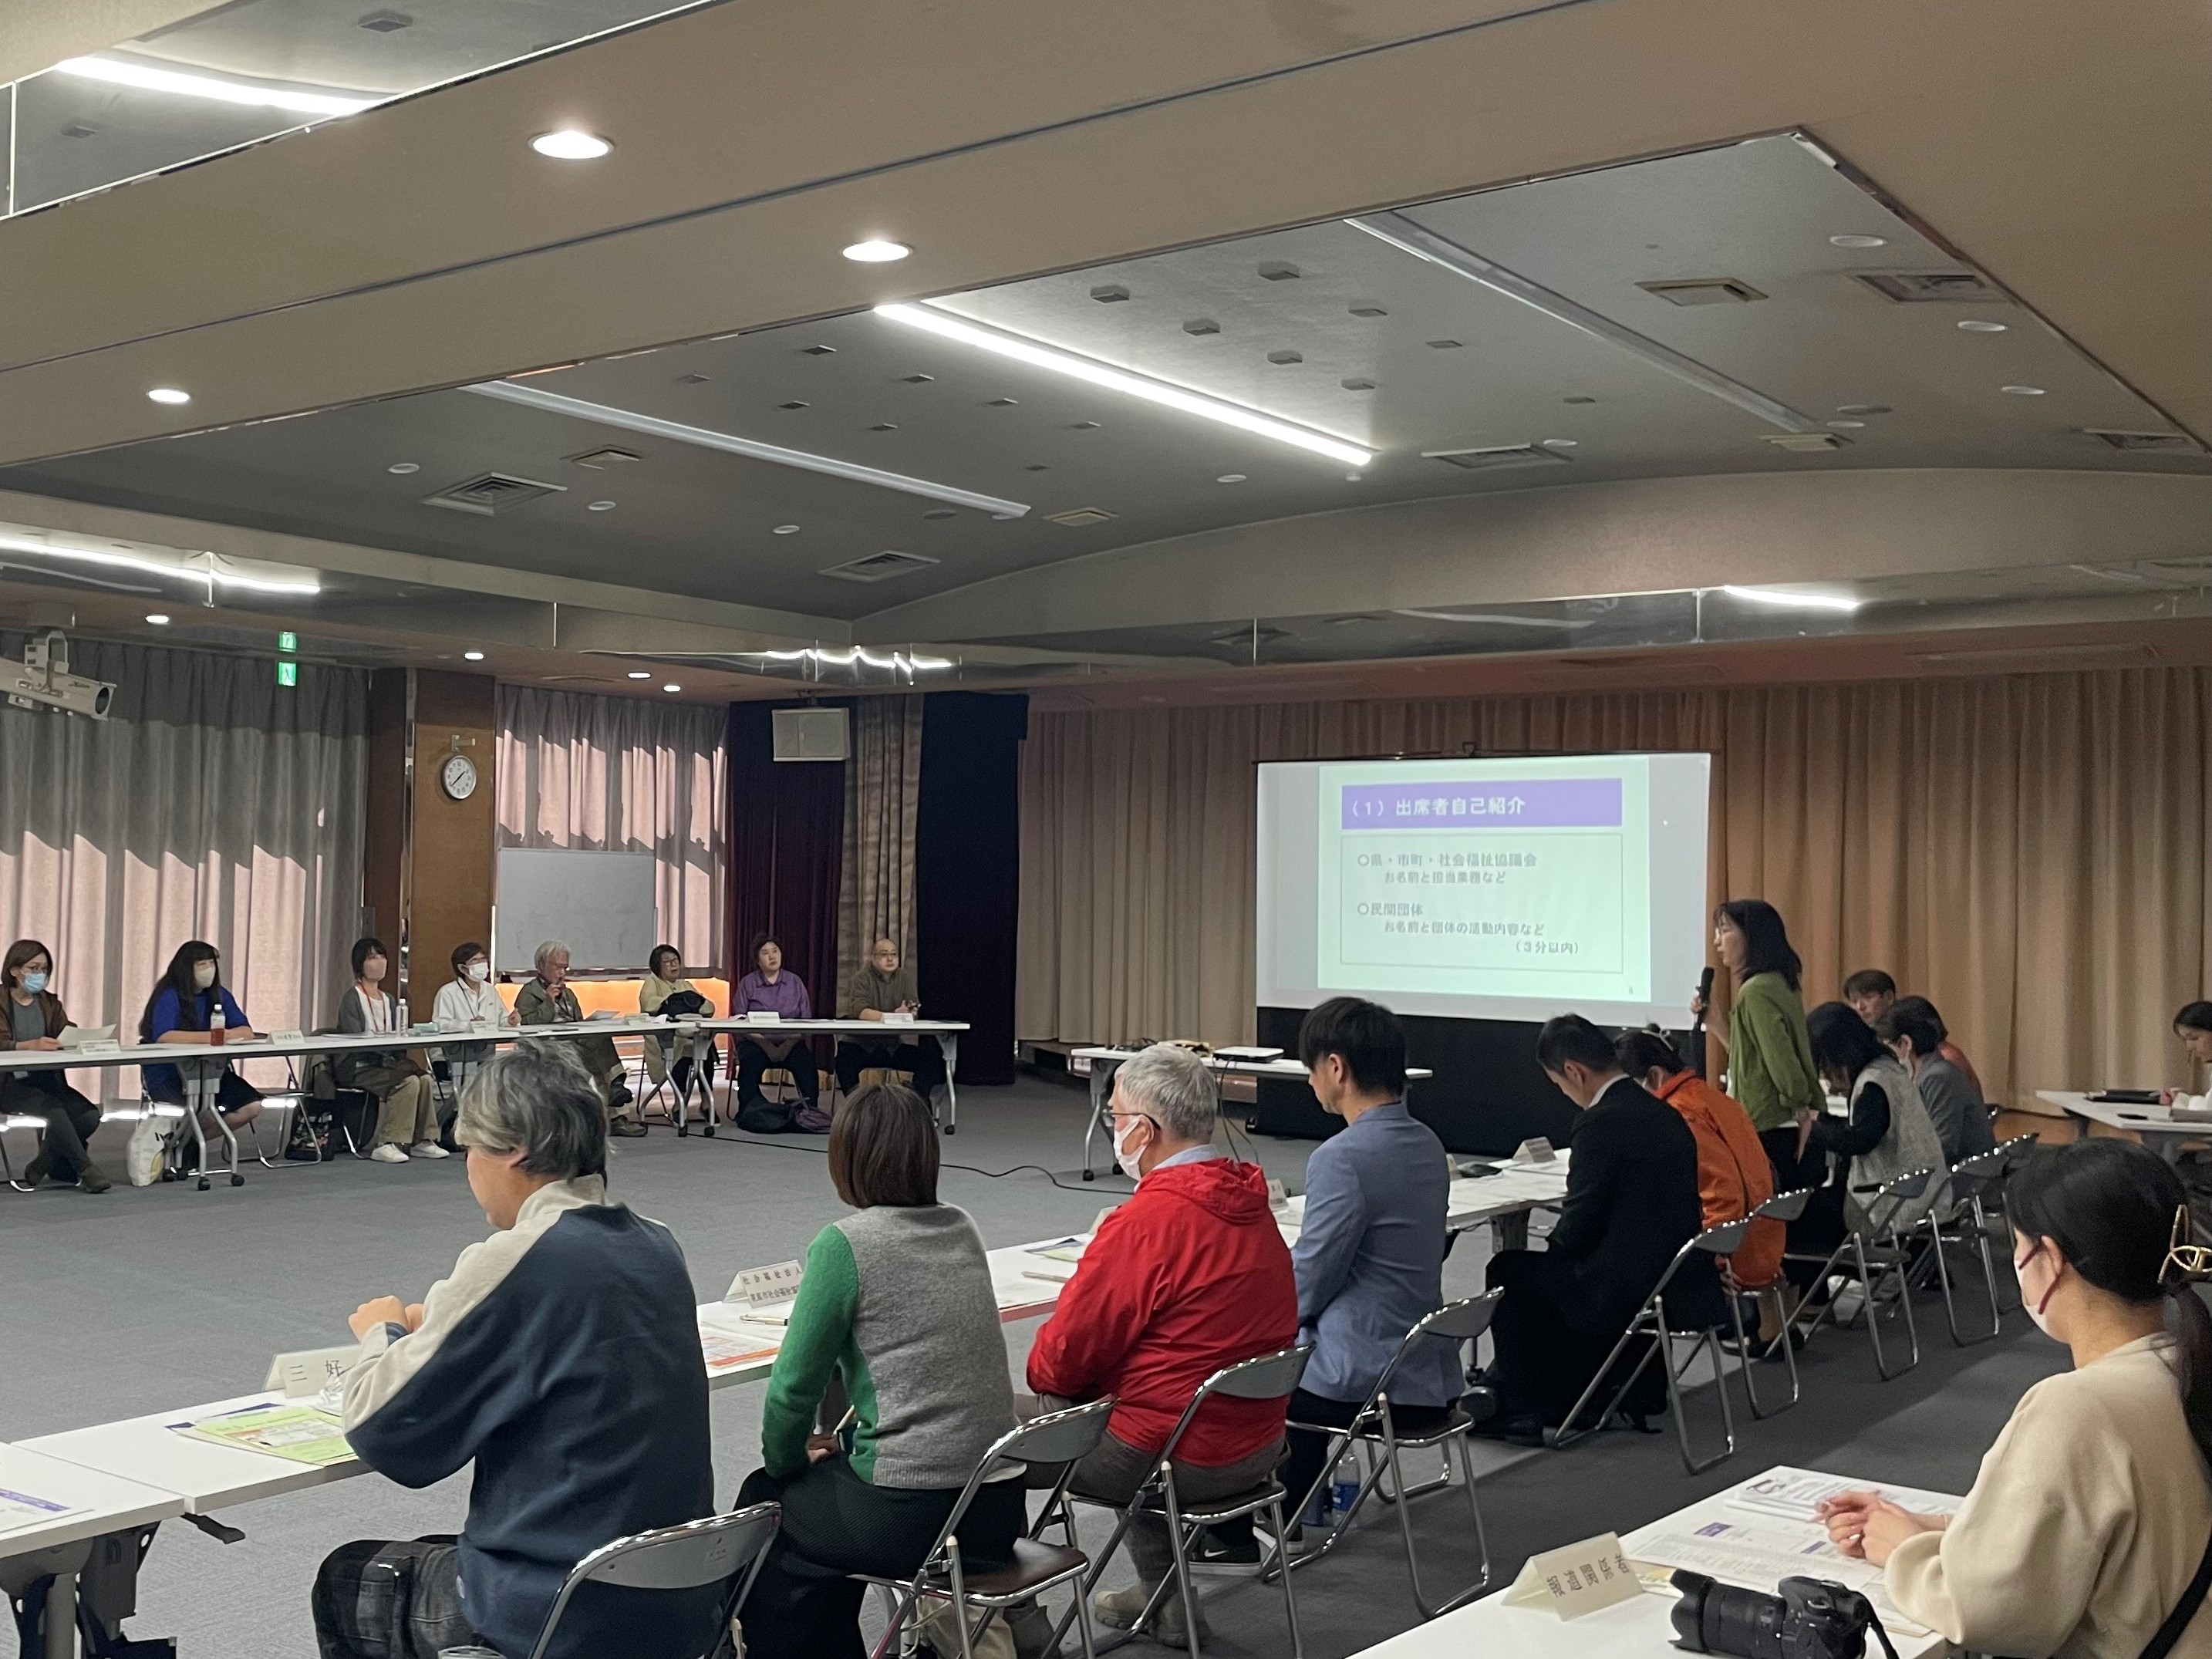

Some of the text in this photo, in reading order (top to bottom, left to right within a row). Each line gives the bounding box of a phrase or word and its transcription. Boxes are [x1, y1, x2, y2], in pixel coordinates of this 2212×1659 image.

[1384, 871, 1506, 885] お名前と担当業務など
[1384, 921, 1546, 936] お名前と団体の活動内容など
[1546, 1553, 1630, 1598] 報道関係者
